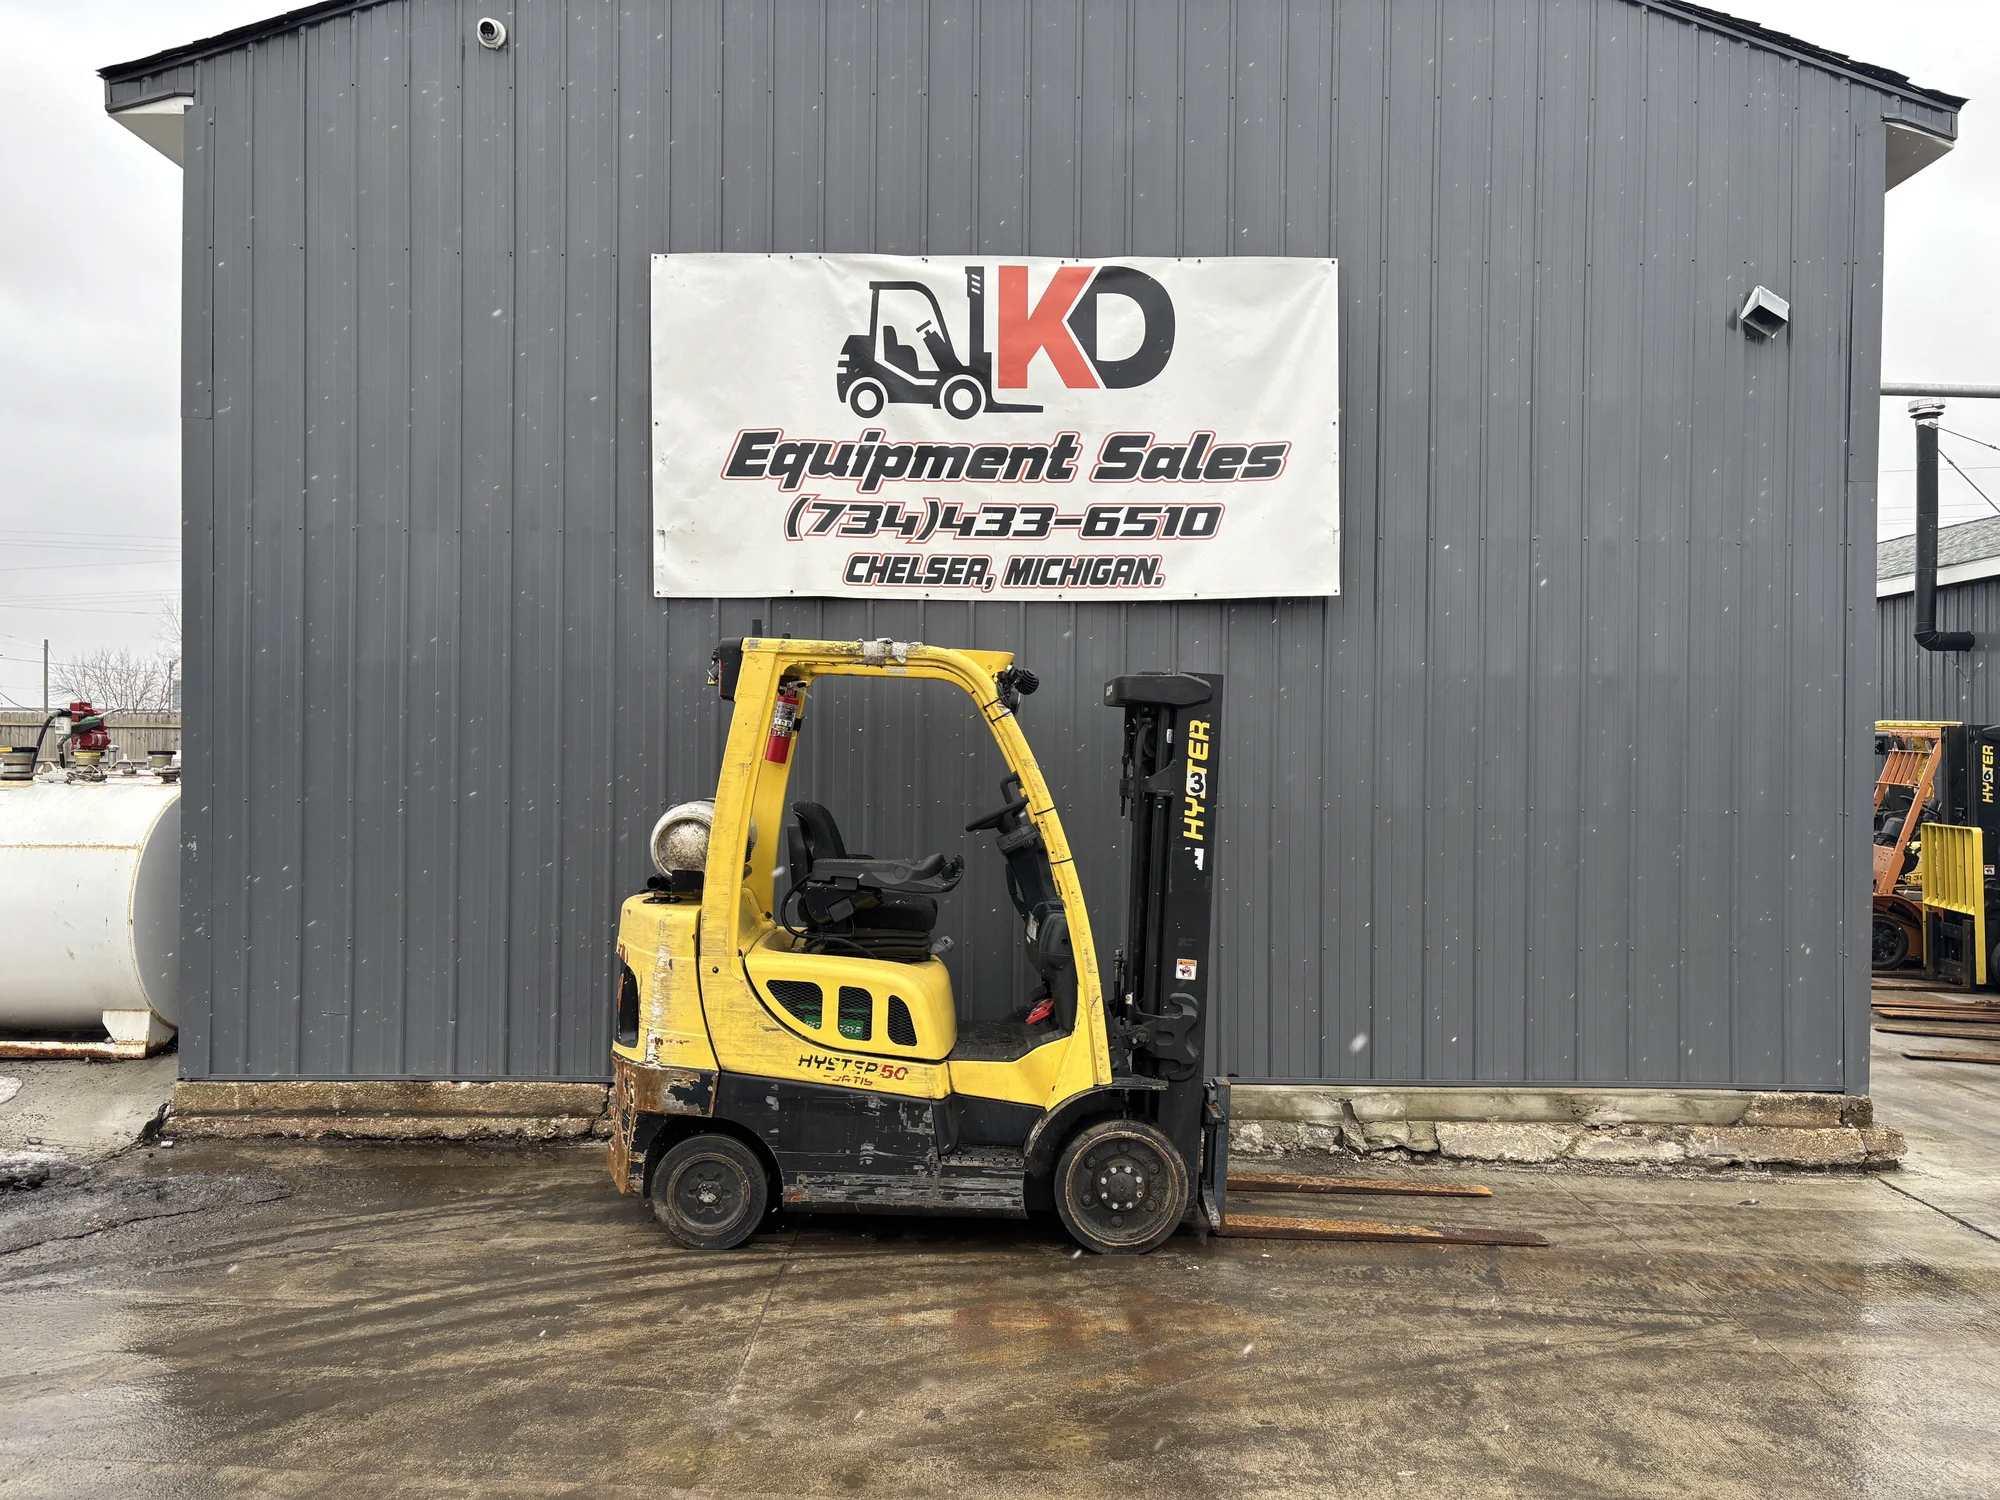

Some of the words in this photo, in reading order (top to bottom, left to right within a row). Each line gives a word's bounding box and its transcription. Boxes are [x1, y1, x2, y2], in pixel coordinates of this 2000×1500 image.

[998, 265, 1176, 390] KD
[722, 429, 1081, 492] Equipment
[1091, 433, 1289, 481] Sales
[785, 496, 1223, 543] (734)433-6510
[844, 554, 995, 591] CHELSEA,
[1002, 556, 1164, 588] MICHIGAN.
[1183, 719, 1211, 841] HYTER
[1189, 772, 1205, 794] 3
[1982, 744, 1994, 803] HYTER
[1983, 770, 1991, 781] 6
[880, 1064, 909, 1081] 50
